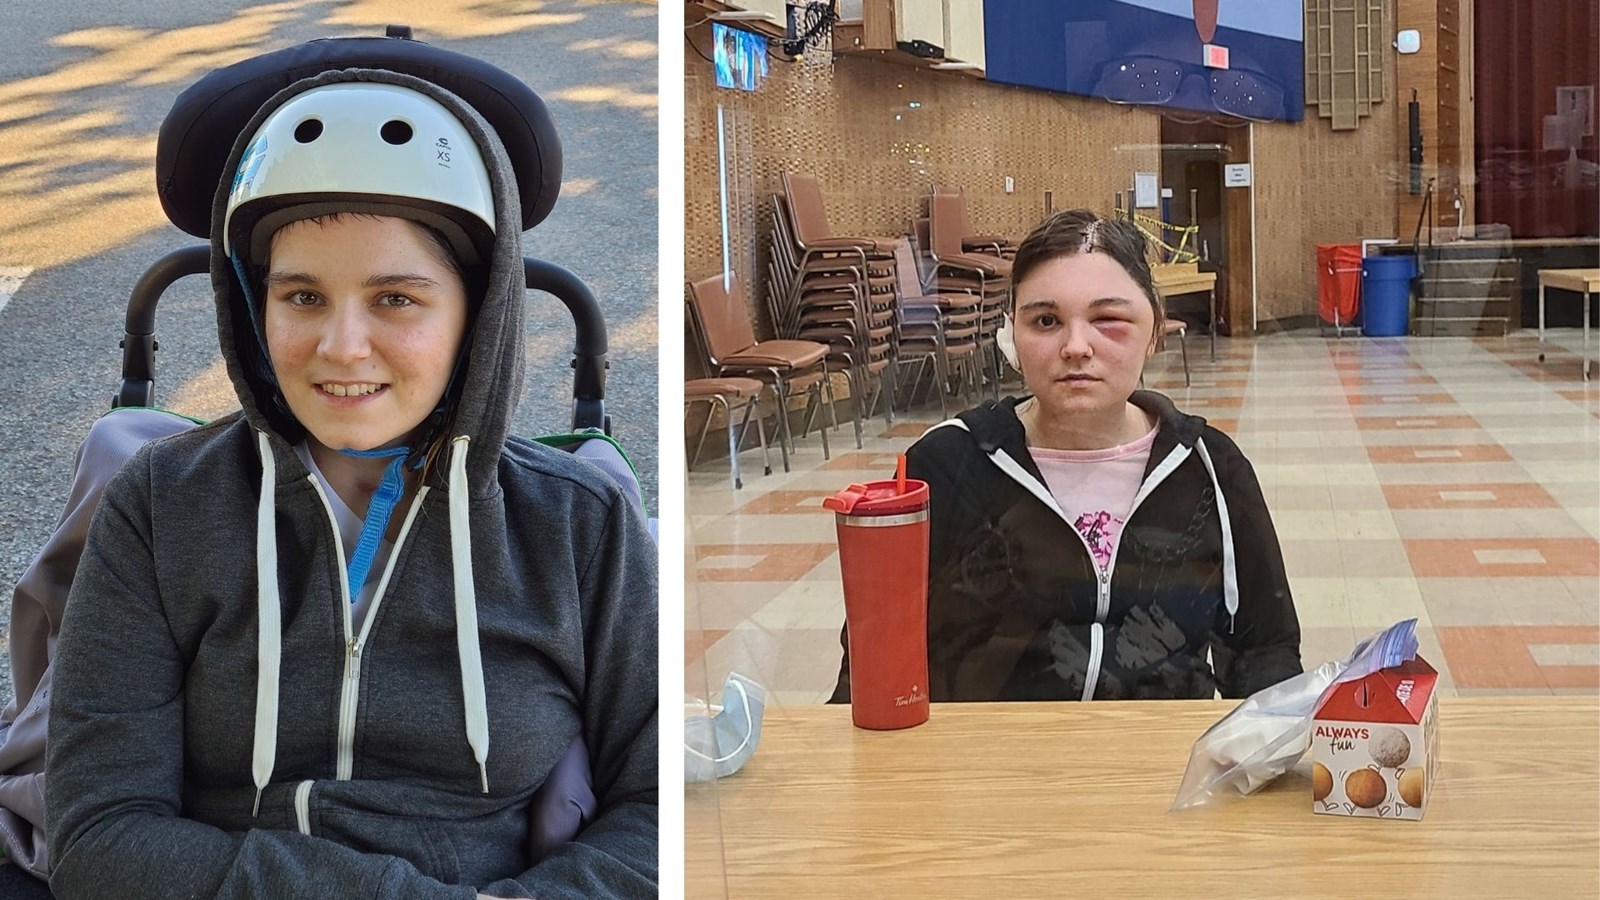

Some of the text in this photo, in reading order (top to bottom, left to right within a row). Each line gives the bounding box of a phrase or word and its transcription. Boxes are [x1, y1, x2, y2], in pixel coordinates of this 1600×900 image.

[437, 150, 450, 162] XS
[1315, 726, 1370, 740] ALWAYS
[1329, 736, 1355, 755] fun
